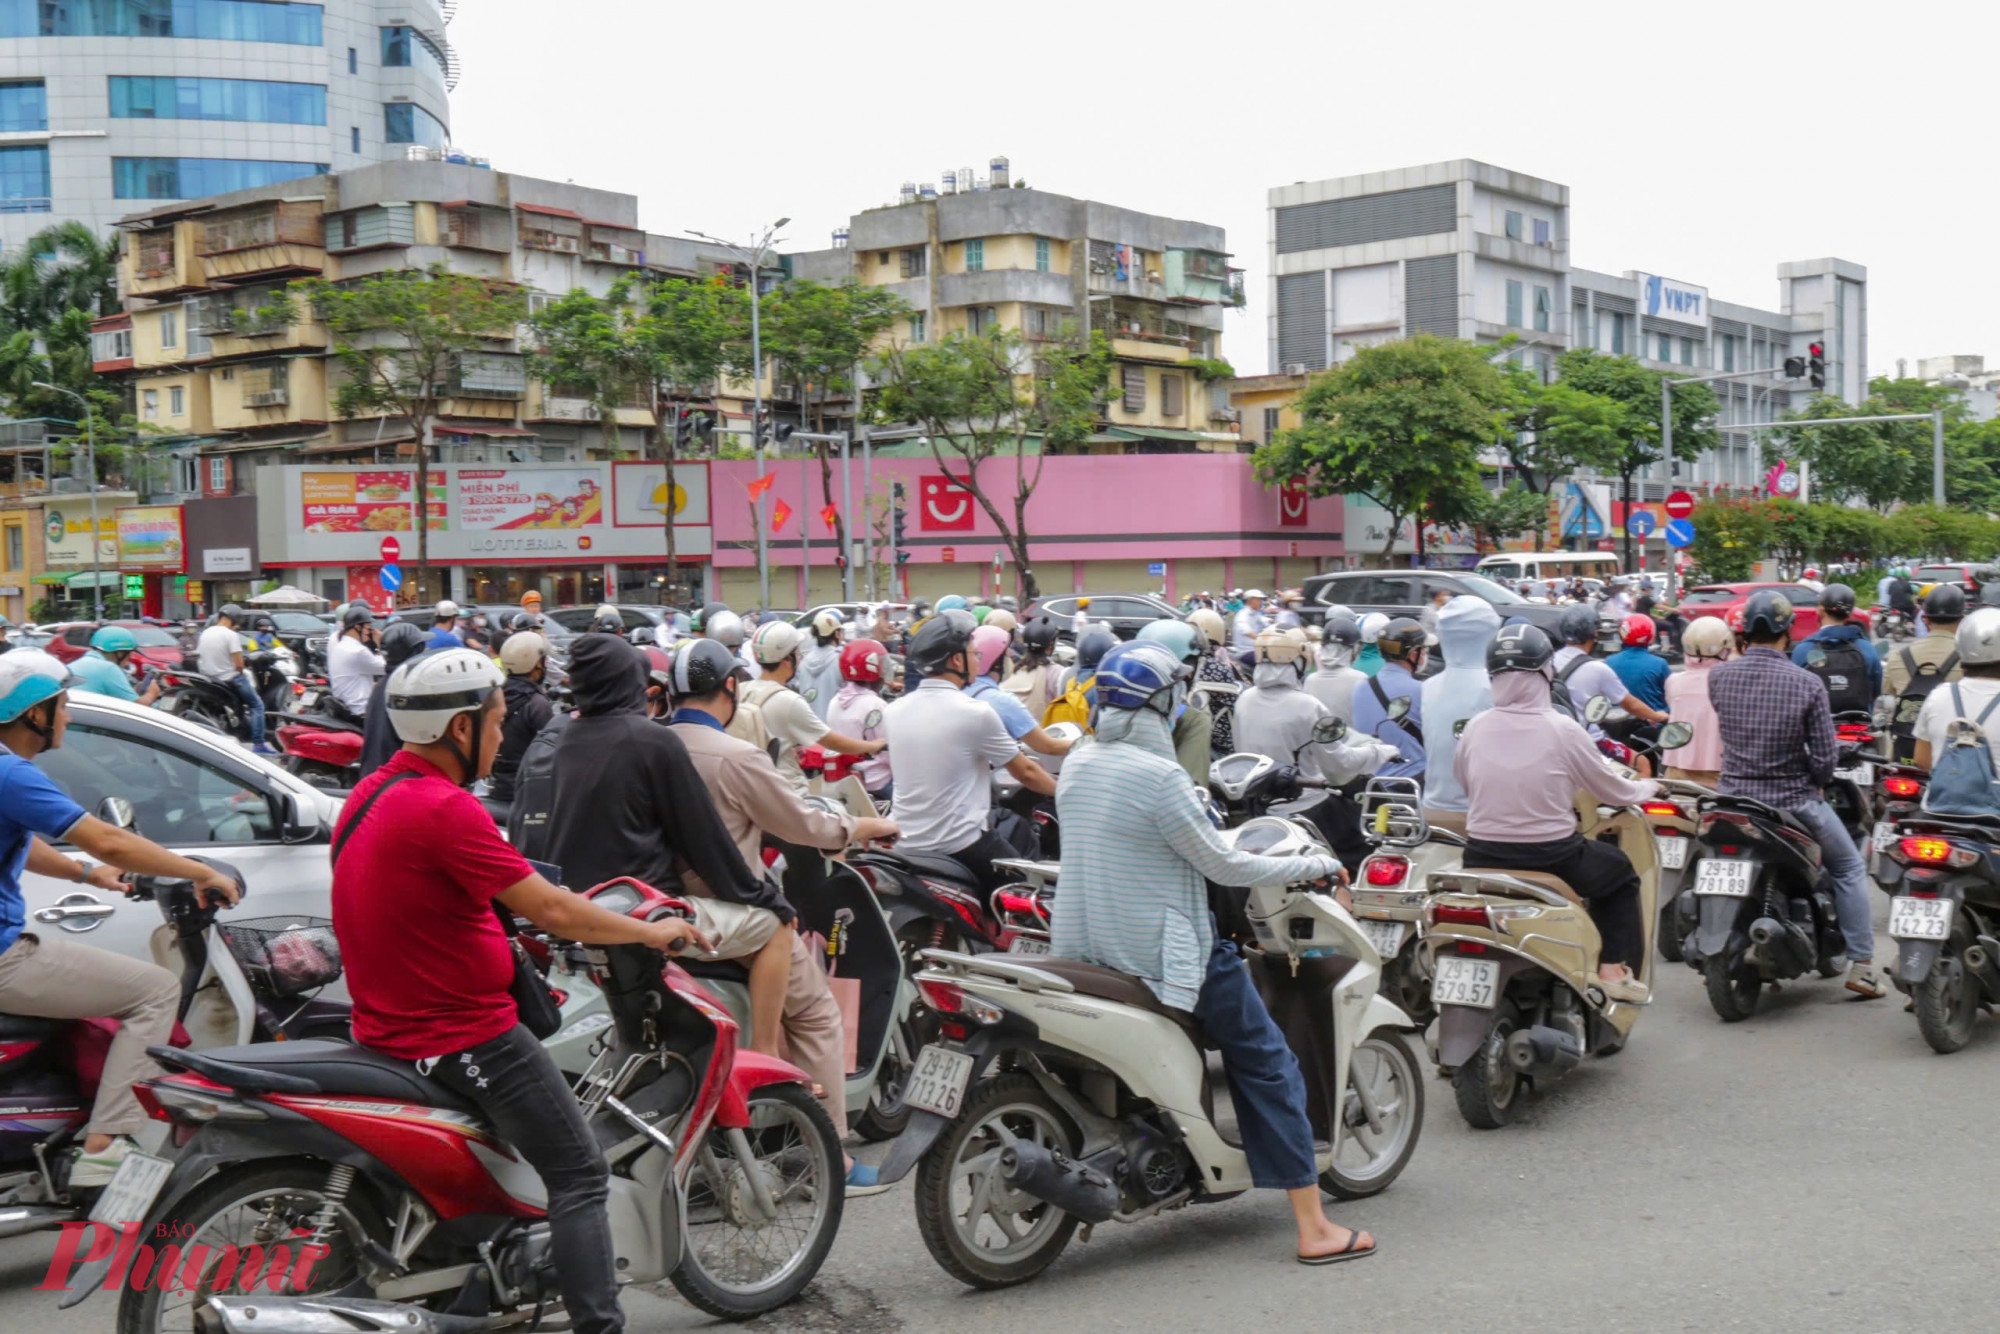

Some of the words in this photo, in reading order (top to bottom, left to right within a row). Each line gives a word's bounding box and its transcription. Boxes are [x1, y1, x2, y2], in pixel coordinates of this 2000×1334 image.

[1664, 286, 1701, 316] VNPT
[460, 480, 494, 493] MIỄN
[497, 480, 519, 493] PHÍ
[470, 537, 568, 551] LOTTERIA
[1898, 901, 1942, 918] 29-B2
[1444, 961, 1490, 982] 29-Y5
[1436, 980, 1492, 1004] 579.57
[921, 1051, 962, 1083] 29-B1
[908, 1075, 958, 1112] 713.26
